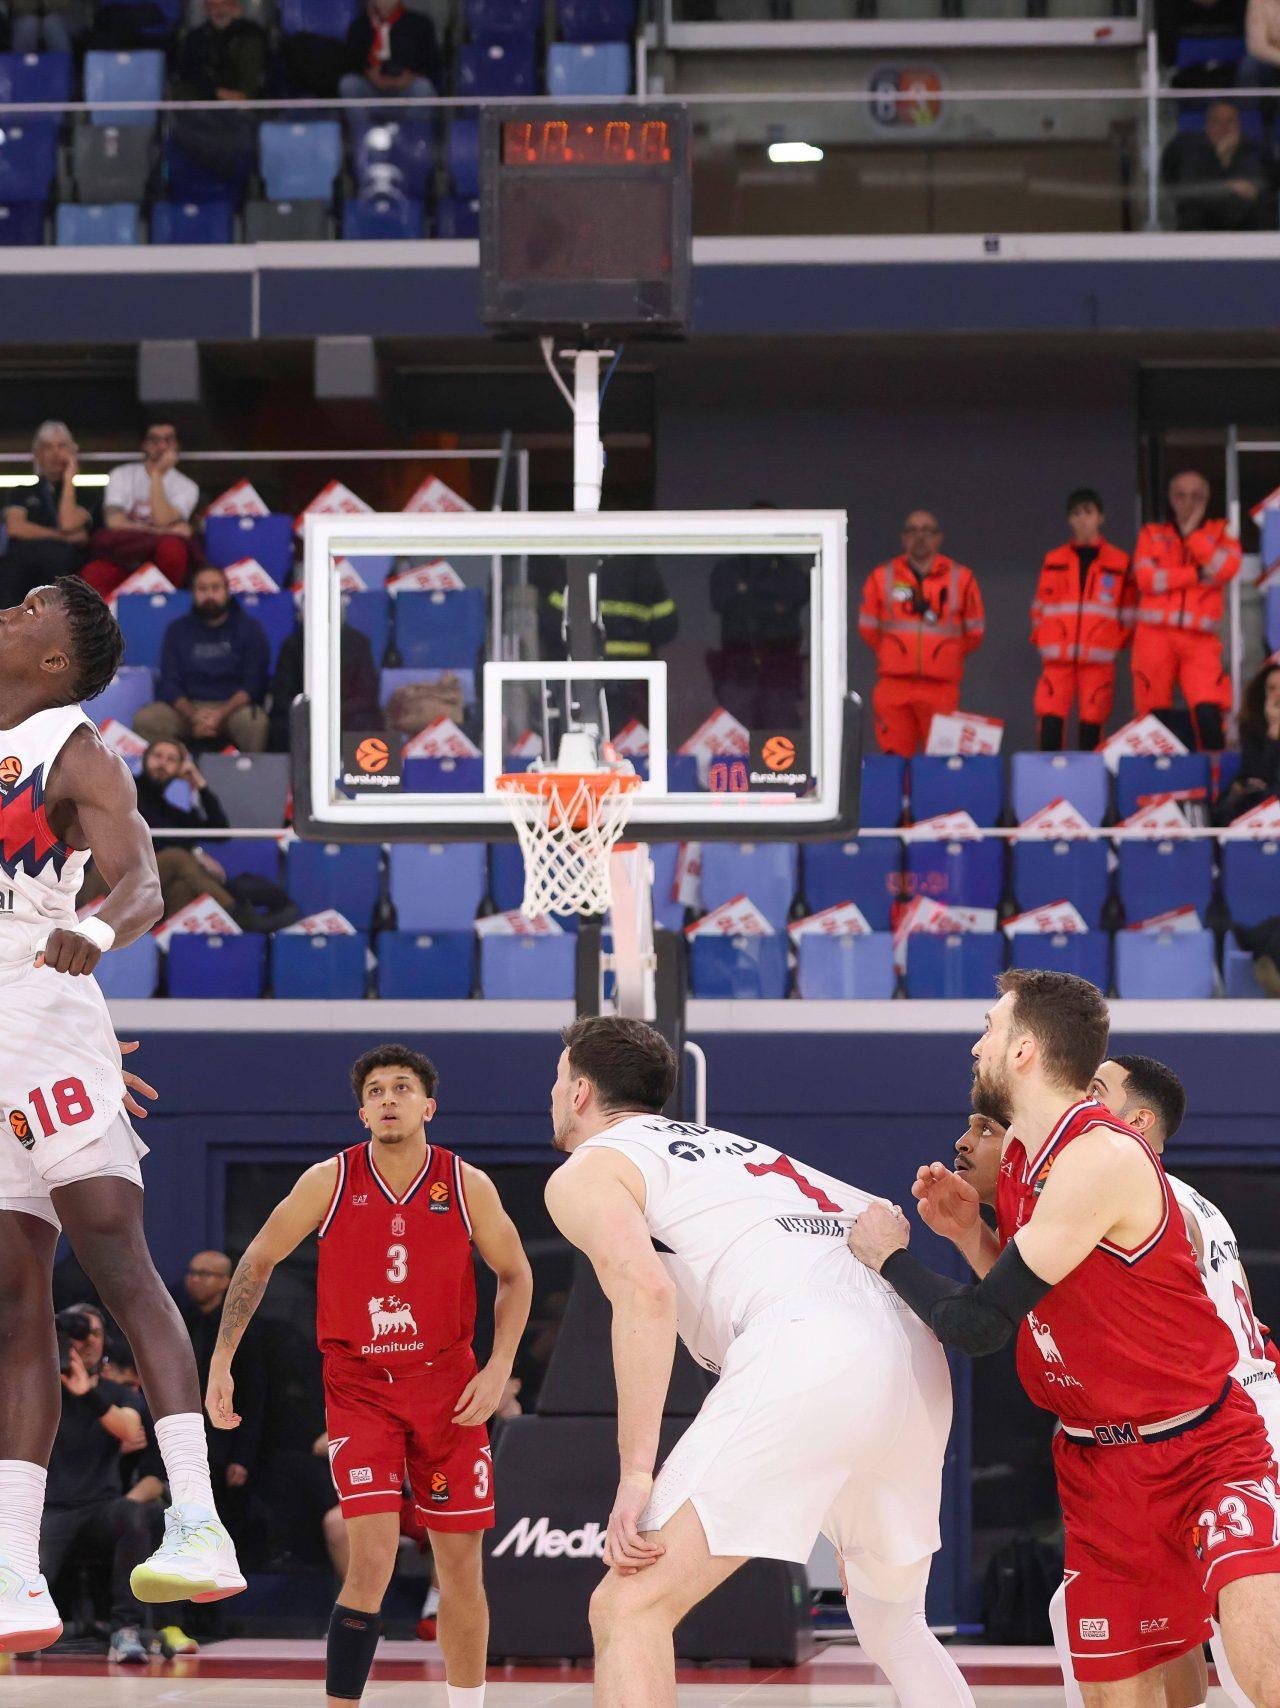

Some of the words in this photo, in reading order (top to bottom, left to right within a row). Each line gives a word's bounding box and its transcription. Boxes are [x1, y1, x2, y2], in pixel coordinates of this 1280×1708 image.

[343, 773, 401, 787] EuroLeague
[750, 772, 807, 786] EuroLeague
[28, 1076, 95, 1138] 18
[387, 1244, 409, 1283] 3
[361, 1340, 425, 1355] plenitude
[1094, 1422, 1138, 1446] OM
[473, 1459, 489, 1499] 3
[1198, 1495, 1254, 1551] 23
[1081, 1621, 1105, 1631] EA7
[1140, 1617, 1169, 1631] EA7
